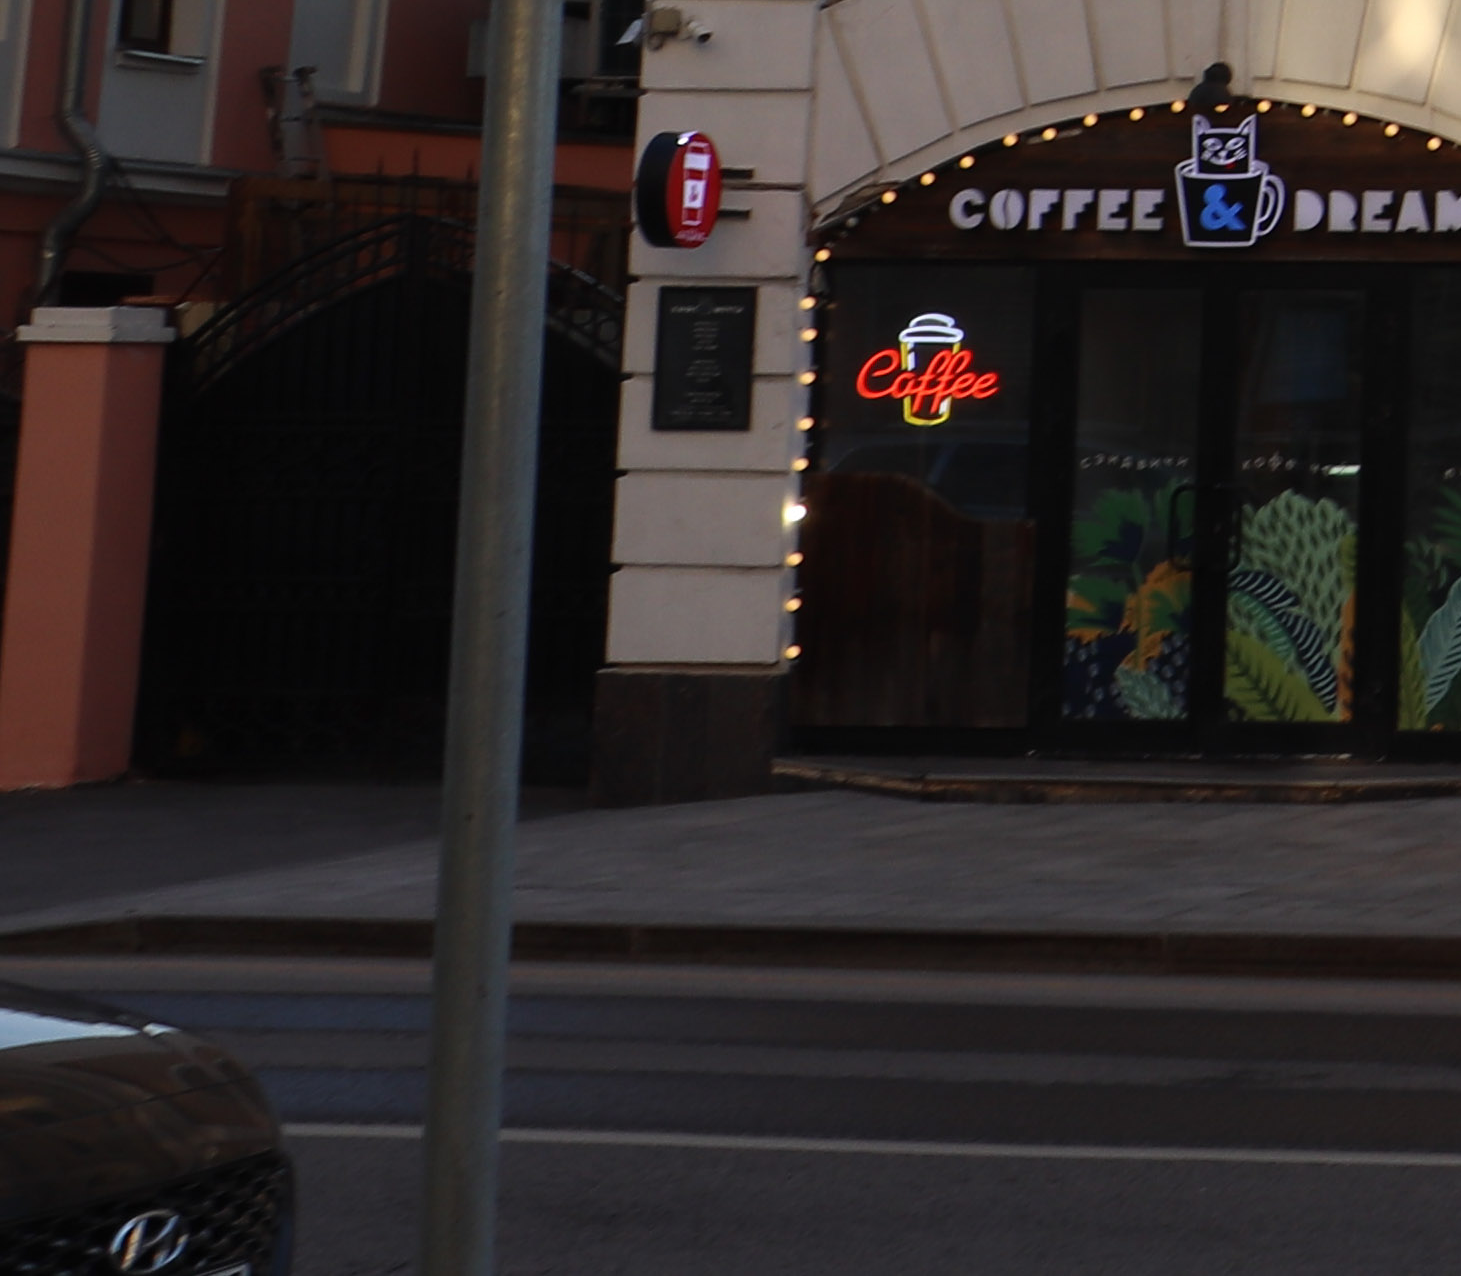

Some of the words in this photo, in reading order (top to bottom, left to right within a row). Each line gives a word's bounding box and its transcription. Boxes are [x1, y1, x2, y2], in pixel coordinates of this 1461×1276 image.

[949, 188, 1165, 231] COFFEE
[1200, 183, 1247, 231] &
[856, 348, 999, 414] Coffee
